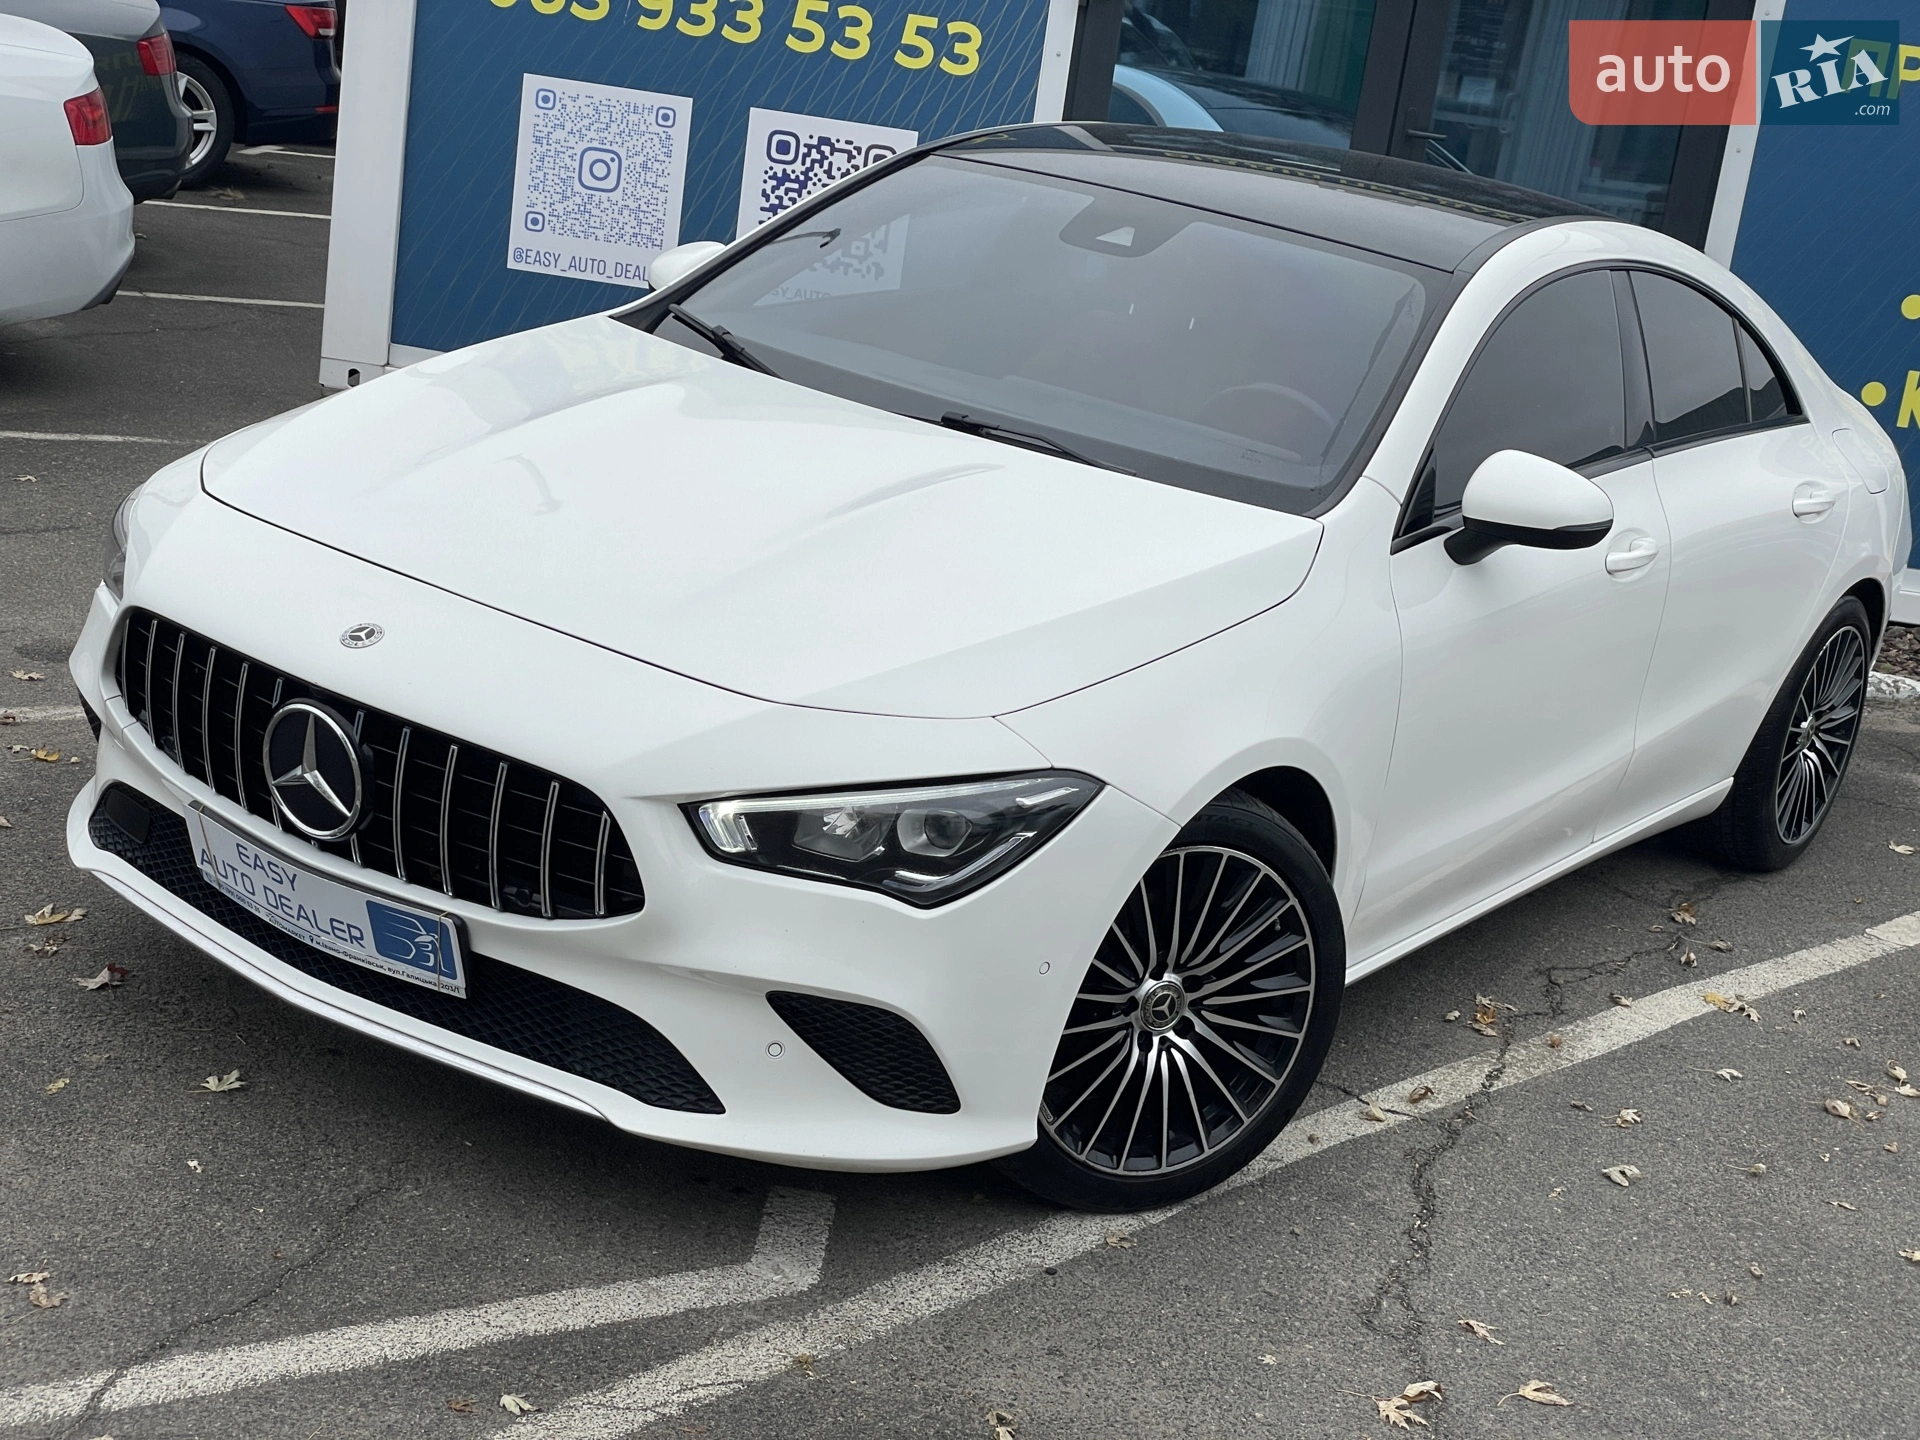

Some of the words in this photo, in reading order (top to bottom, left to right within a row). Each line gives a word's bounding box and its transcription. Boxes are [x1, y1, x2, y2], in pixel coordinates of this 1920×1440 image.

[637, 0, 763, 44] 933
[784, 1, 873, 60] 53
[893, 15, 983, 76] 53
[201, 848, 256, 896] AUTO
[262, 884, 367, 949] DEALER
[236, 842, 298, 891] EASY
